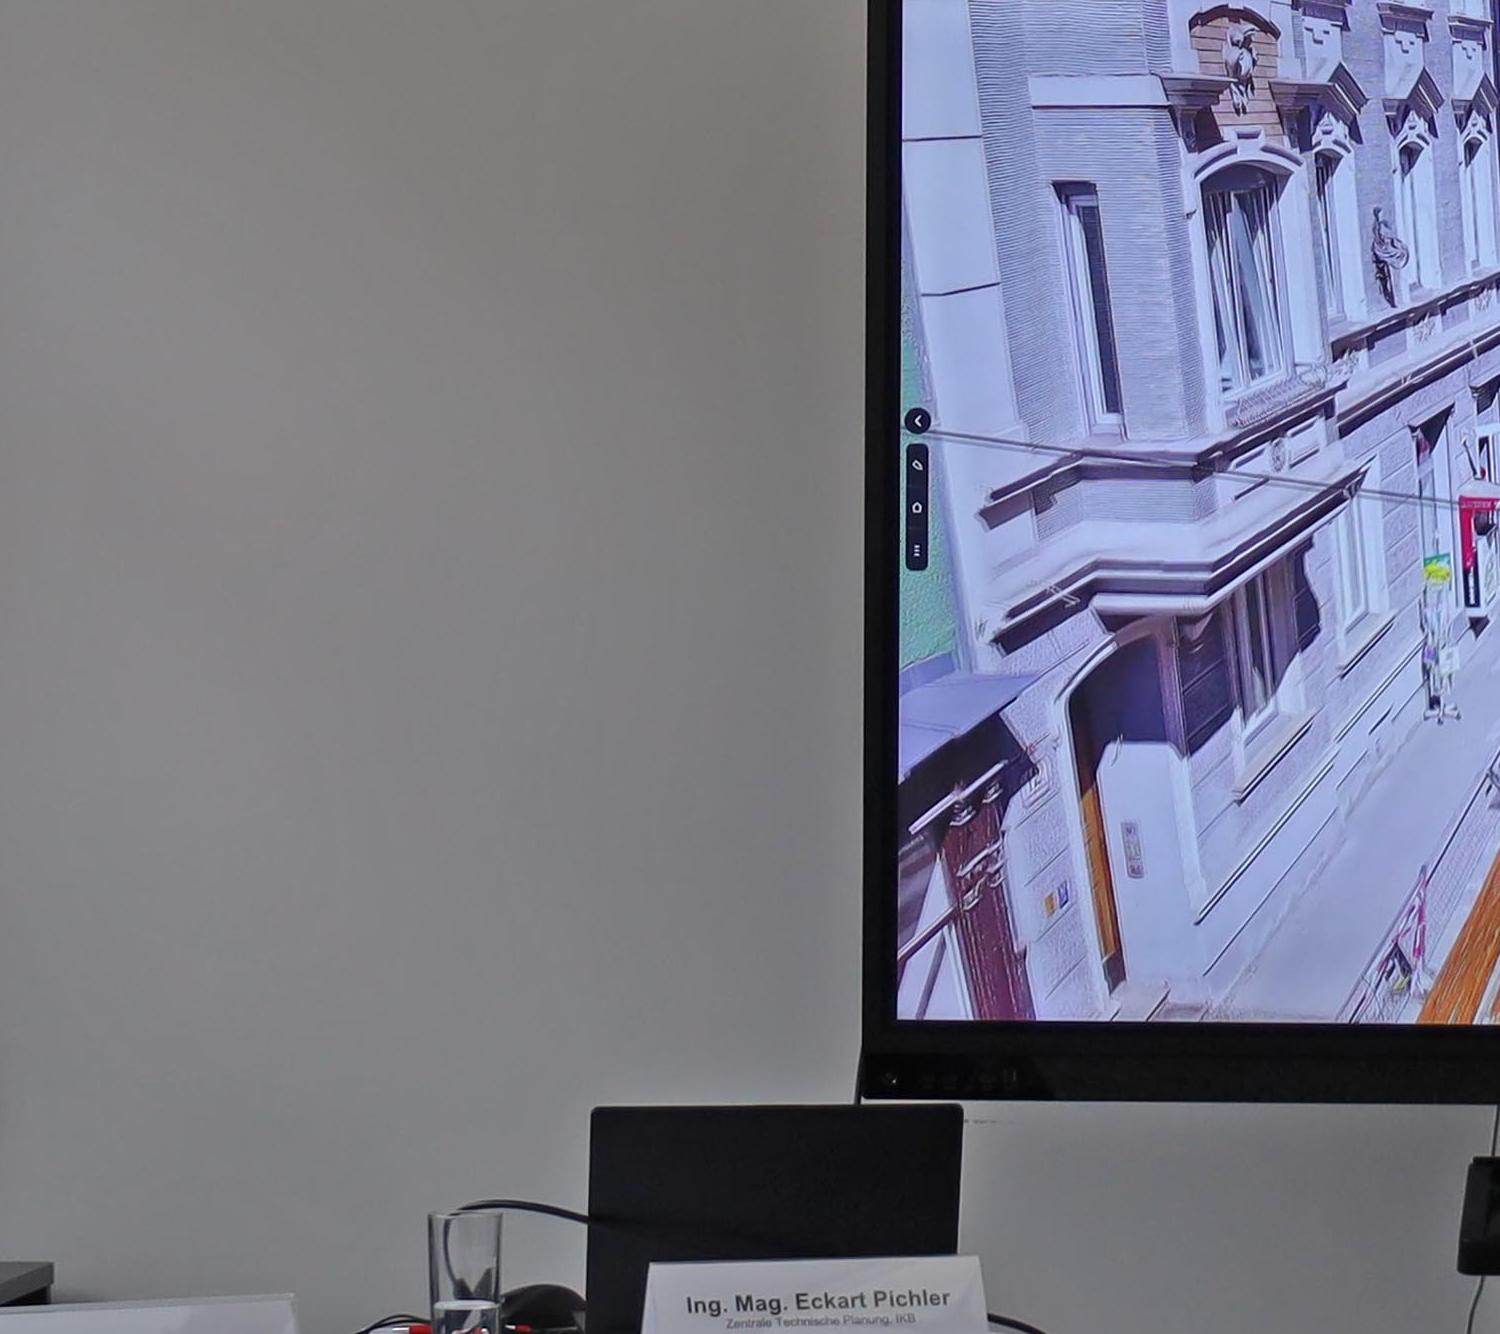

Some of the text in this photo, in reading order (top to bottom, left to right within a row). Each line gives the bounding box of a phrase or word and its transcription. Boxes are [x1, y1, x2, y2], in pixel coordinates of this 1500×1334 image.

[686, 1288, 951, 1317] Ing. Mag. Eckart Pichler
[726, 1316, 772, 1330] Zentrale
[776, 1315, 840, 1328] Technische
[895, 1313, 917, 1324] IKB
